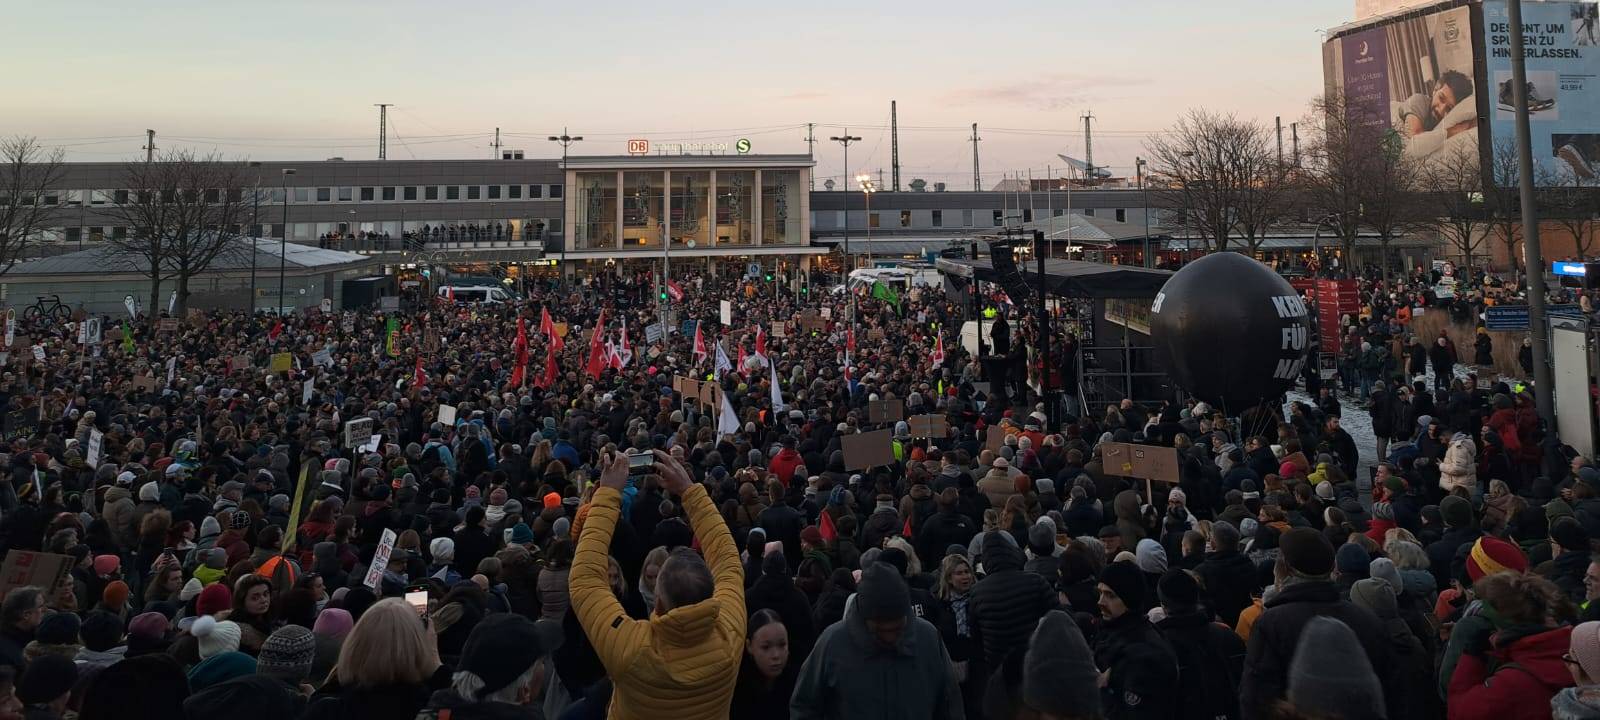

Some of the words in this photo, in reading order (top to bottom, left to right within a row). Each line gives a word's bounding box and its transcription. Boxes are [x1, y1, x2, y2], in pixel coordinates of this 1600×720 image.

[1490, 22, 1544, 35] DESGNT,
[1546, 23, 1565, 34] UM
[1492, 35, 1537, 46] SPUEN
[1538, 36, 1555, 46] ZU
[1492, 47, 1583, 59] HINERLASSEN.
[630, 141, 646, 152] DB
